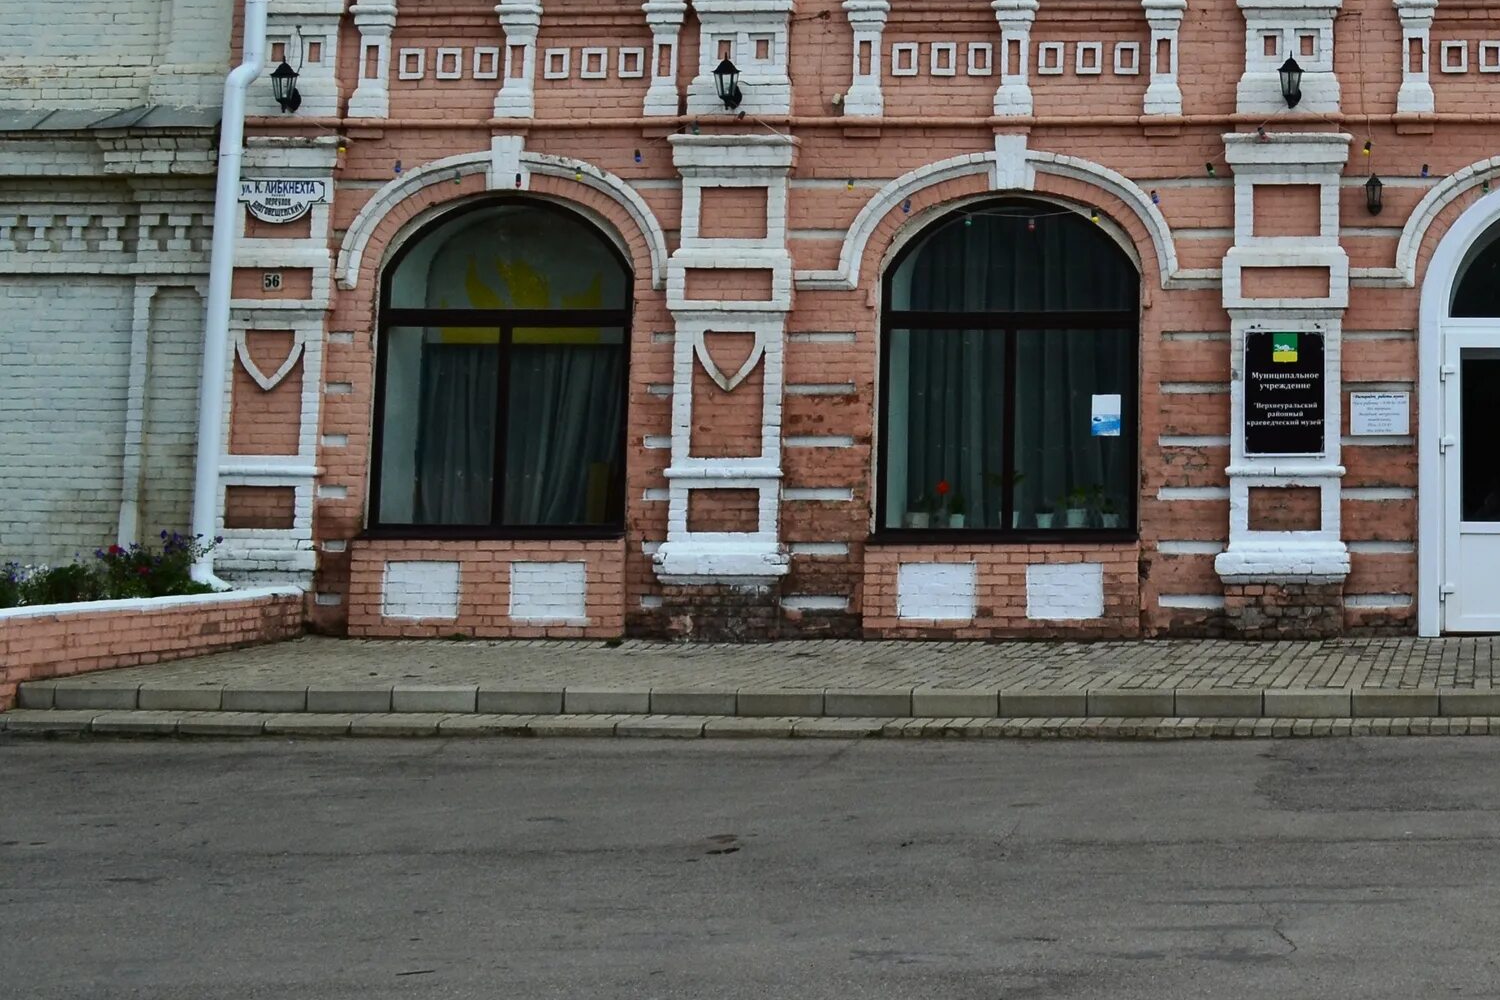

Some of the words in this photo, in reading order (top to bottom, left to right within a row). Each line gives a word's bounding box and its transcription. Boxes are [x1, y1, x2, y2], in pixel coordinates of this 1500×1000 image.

[242, 185, 252, 195] ул.
[255, 181, 263, 193] К.
[265, 181, 316, 194] ЛИБКНЕХТА
[265, 275, 280, 287] 56
[1251, 371, 1320, 381] Муниципальное
[1259, 382, 1311, 391] учреждение
[1253, 402, 1318, 410] "Верхнеуральский
[1246, 419, 1299, 427] краеведческий
